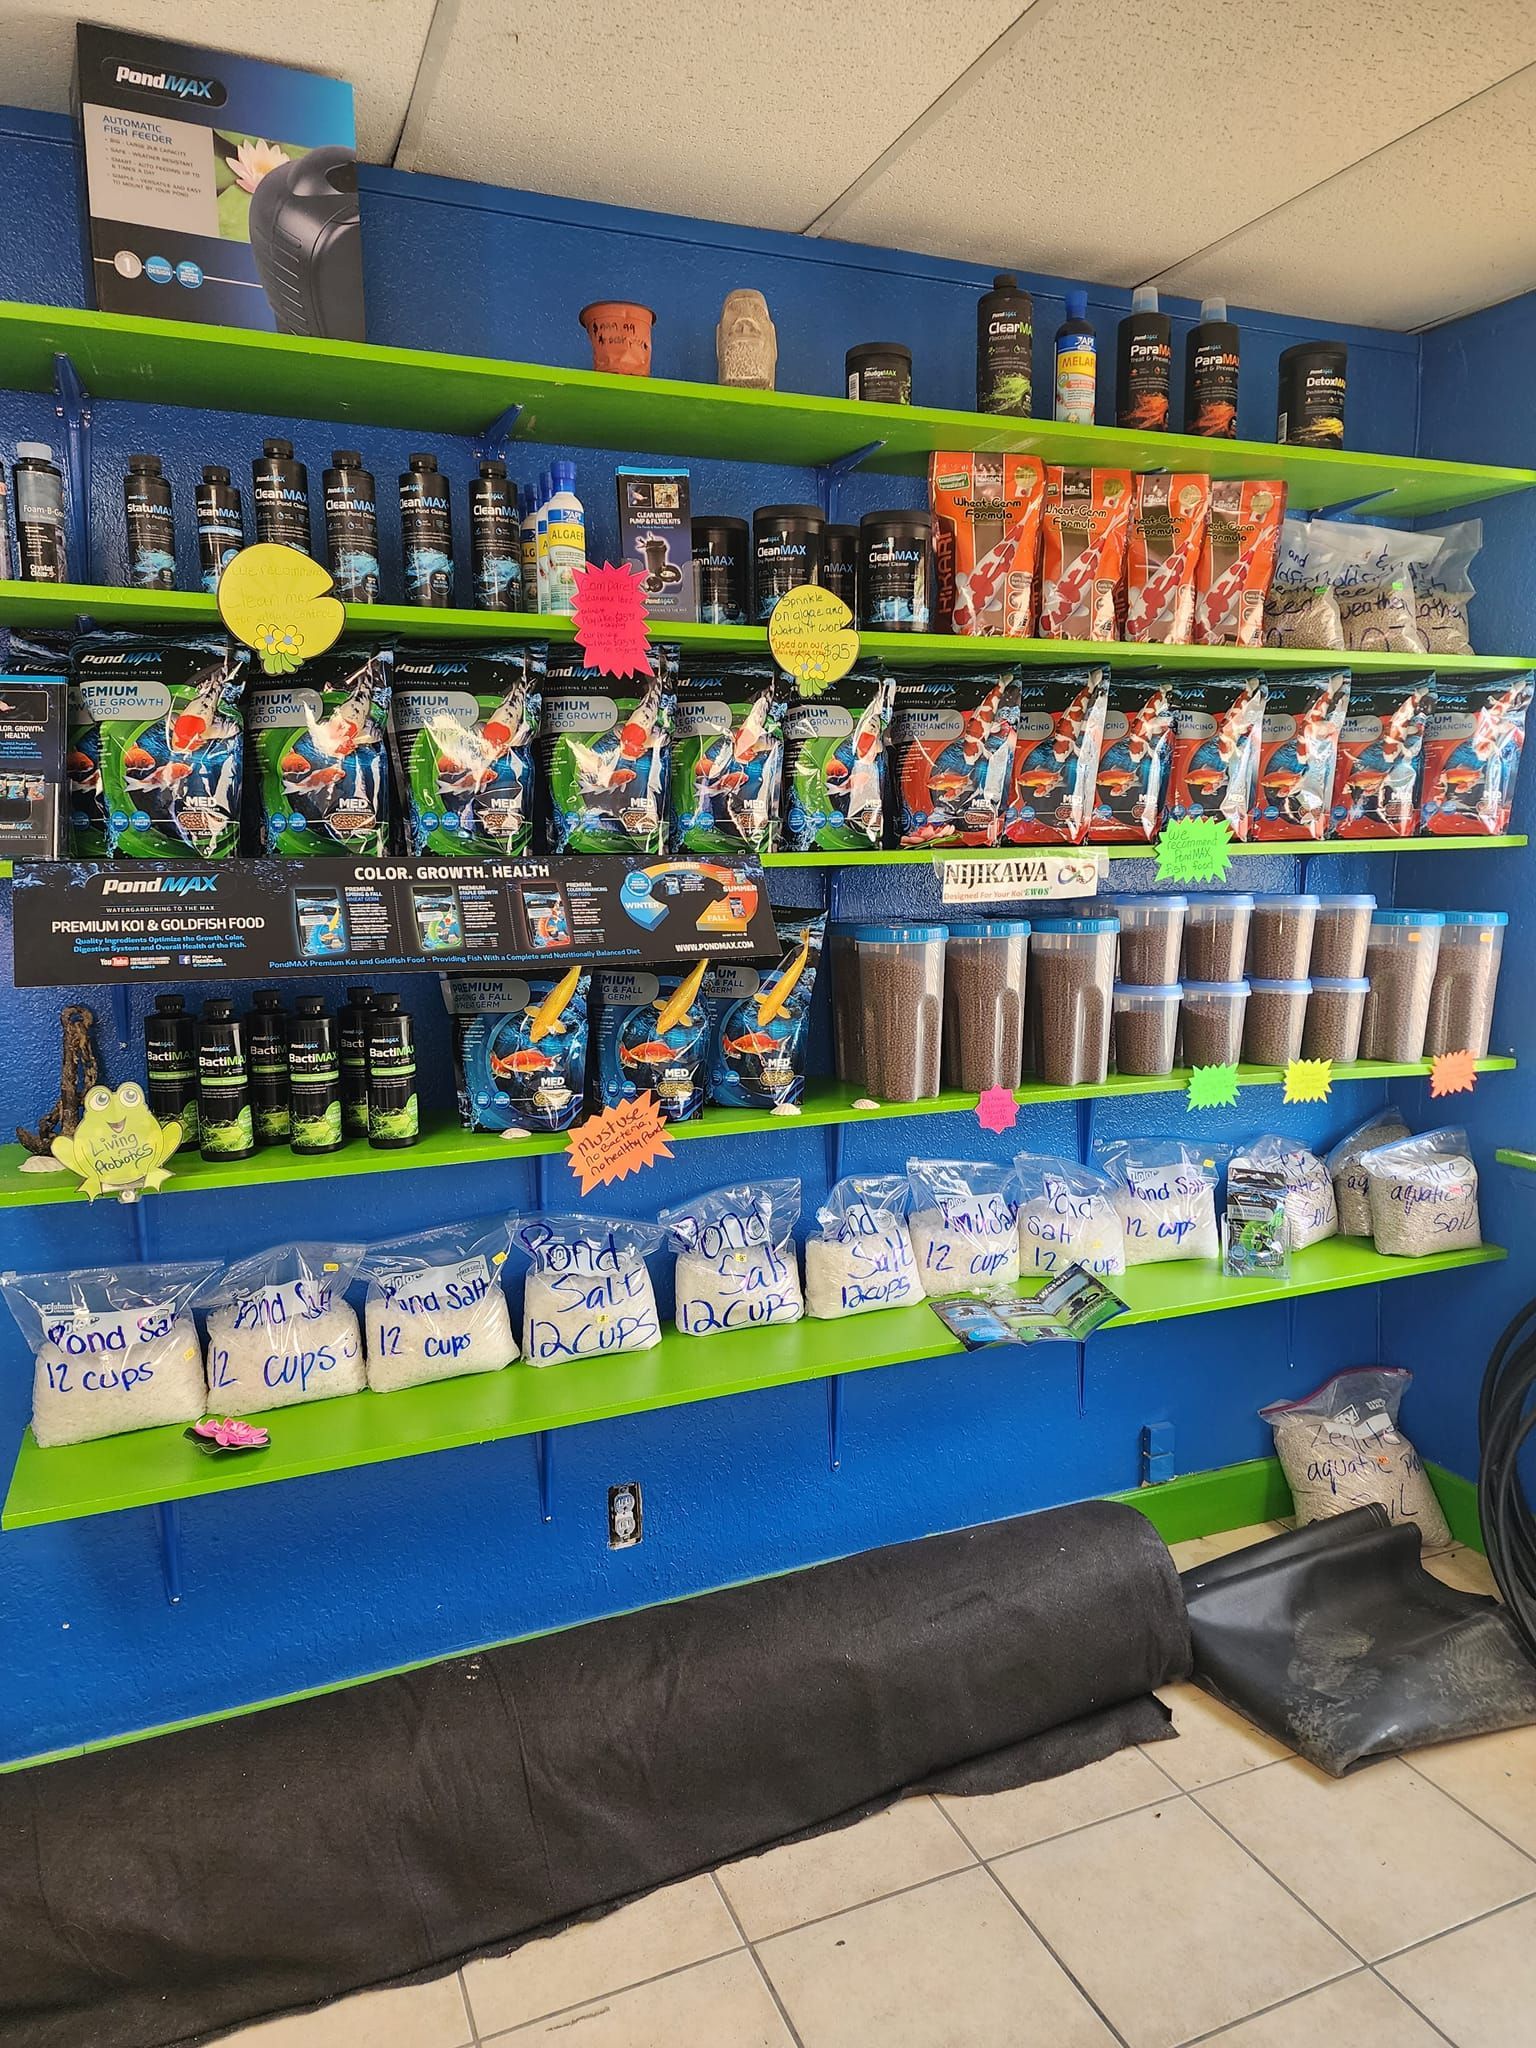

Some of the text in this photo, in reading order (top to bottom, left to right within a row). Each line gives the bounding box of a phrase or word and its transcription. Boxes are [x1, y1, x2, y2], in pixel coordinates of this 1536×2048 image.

[116, 65, 214, 99] PondMAX
[103, 114, 162, 133] AUTOMATIC
[104, 124, 173, 145] FISH FEEDER
[953, 496, 1022, 508] Wheat-Germ
[965, 510, 1013, 520] Formula
[1053, 518, 1096, 530] Formula
[1136, 526, 1181, 536] Formula
[757, 544, 807, 557] CleanMAX
[869, 550, 919, 563] CleanMAX
[782, 592, 822, 607] Sprinkle
[81, 652, 164, 666] PondMAX
[110, 698, 164, 707] GROWTH
[268, 704, 317, 715] GROWTH
[685, 714, 727, 725] GROWTH
[912, 721, 961, 731] ENHANCING
[186, 796, 217, 807] MED
[339, 798, 369, 809] MED
[491, 798, 517, 809] MED
[630, 797, 654, 808] MED
[744, 799, 765, 809] MED
[1167, 832, 1218, 850] recommend
[354, 865, 550, 881] COLOR. GROWTH. HEALTH
[945, 861, 1049, 889] NIJIKAWA
[102, 873, 220, 897] PondMAX
[723, 884, 758, 892] SUMMER
[943, 892, 979, 900] Designed
[993, 891, 1010, 899] Your
[51, 916, 265, 933] PREMIUM KOI & GOLDFISH FOOD
[707, 914, 729, 922] FALL
[75, 937, 103, 946] Quality
[104, 935, 147, 946] Ingredients
[148, 934, 181, 944] Optimize
[182, 934, 194, 942] the
[675, 940, 755, 953] WWW.PONDMAX.COM
[73, 944, 110, 954] Digestive
[111, 943, 139, 953] System
[141, 943, 154, 951] and
[156, 943, 181, 951] Overall
[182, 942, 206, 950] Health
[216, 941, 228, 949] the
[269, 960, 308, 969] PondMAX
[309, 958, 344, 967] Premium
[345, 957, 358, 966] Koi
[359, 957, 373, 965] and
[374, 955, 406, 965] Goldfish
[407, 955, 426, 963] Food
[432, 954, 467, 964] Providing
[467, 953, 482, 963] Fish
[482, 953, 500, 962] With
[506, 952, 540, 962] Complete
[541, 952, 553, 960] and
[553, 950, 596, 960] Nutritionally
[596, 949, 626, 958] Balanced
[723, 978, 744, 988] FALL
[607, 992, 632, 1001] GERM
[619, 985, 643, 995] FALL
[492, 993, 513, 1002] FALL
[767, 1058, 792, 1069] MED
[665, 1068, 690, 1079] MED
[541, 1076, 565, 1087] MED
[90, 1132, 139, 1157] Living
[1127, 1177, 1170, 1202] Pond
[674, 1200, 767, 1260] Pond
[1027, 1215, 1075, 1245] Salt
[1126, 1216, 1197, 1245] 12 cups
[520, 1223, 621, 1272] Pond
[848, 1228, 914, 1280] Salt
[927, 1241, 1013, 1276] 12 cups
[718, 1244, 788, 1296] Salt
[445, 1276, 488, 1310] Salt
[549, 1270, 645, 1313] Salt
[380, 1325, 472, 1359] 12 cups
[213, 1344, 337, 1393] 12 cups
[47, 1361, 154, 1393] 12 cups
[1307, 1455, 1392, 1495] aquatic
